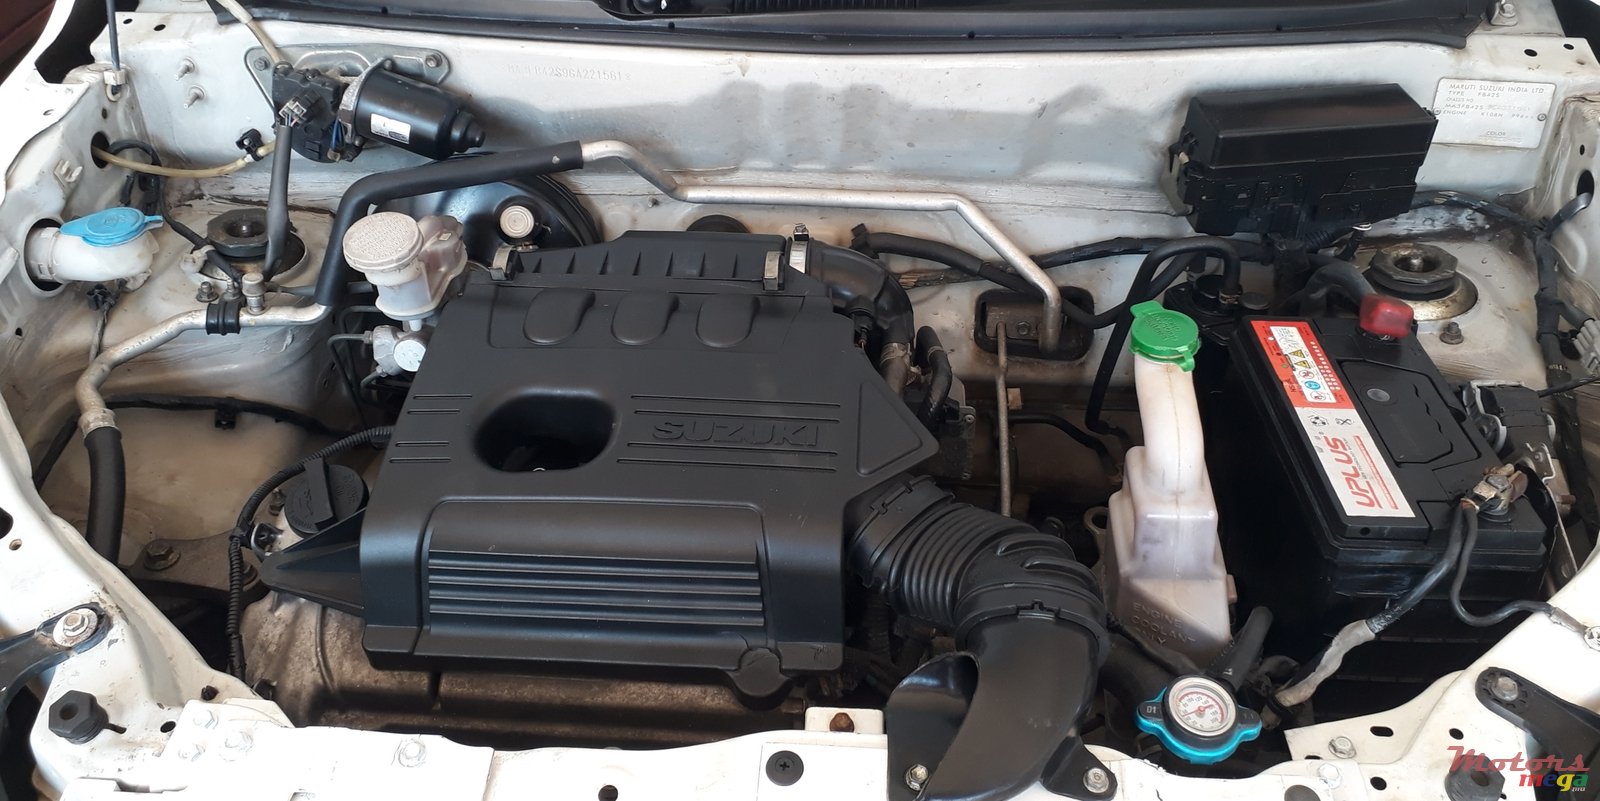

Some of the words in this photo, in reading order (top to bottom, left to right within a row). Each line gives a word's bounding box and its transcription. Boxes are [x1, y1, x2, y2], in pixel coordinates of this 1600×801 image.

[653, 421, 819, 447] SUZUKI
[1323, 435, 1376, 509] UPLUS
[1132, 615, 1196, 643] COOLANT
[1133, 602, 1182, 629] ENGINE
